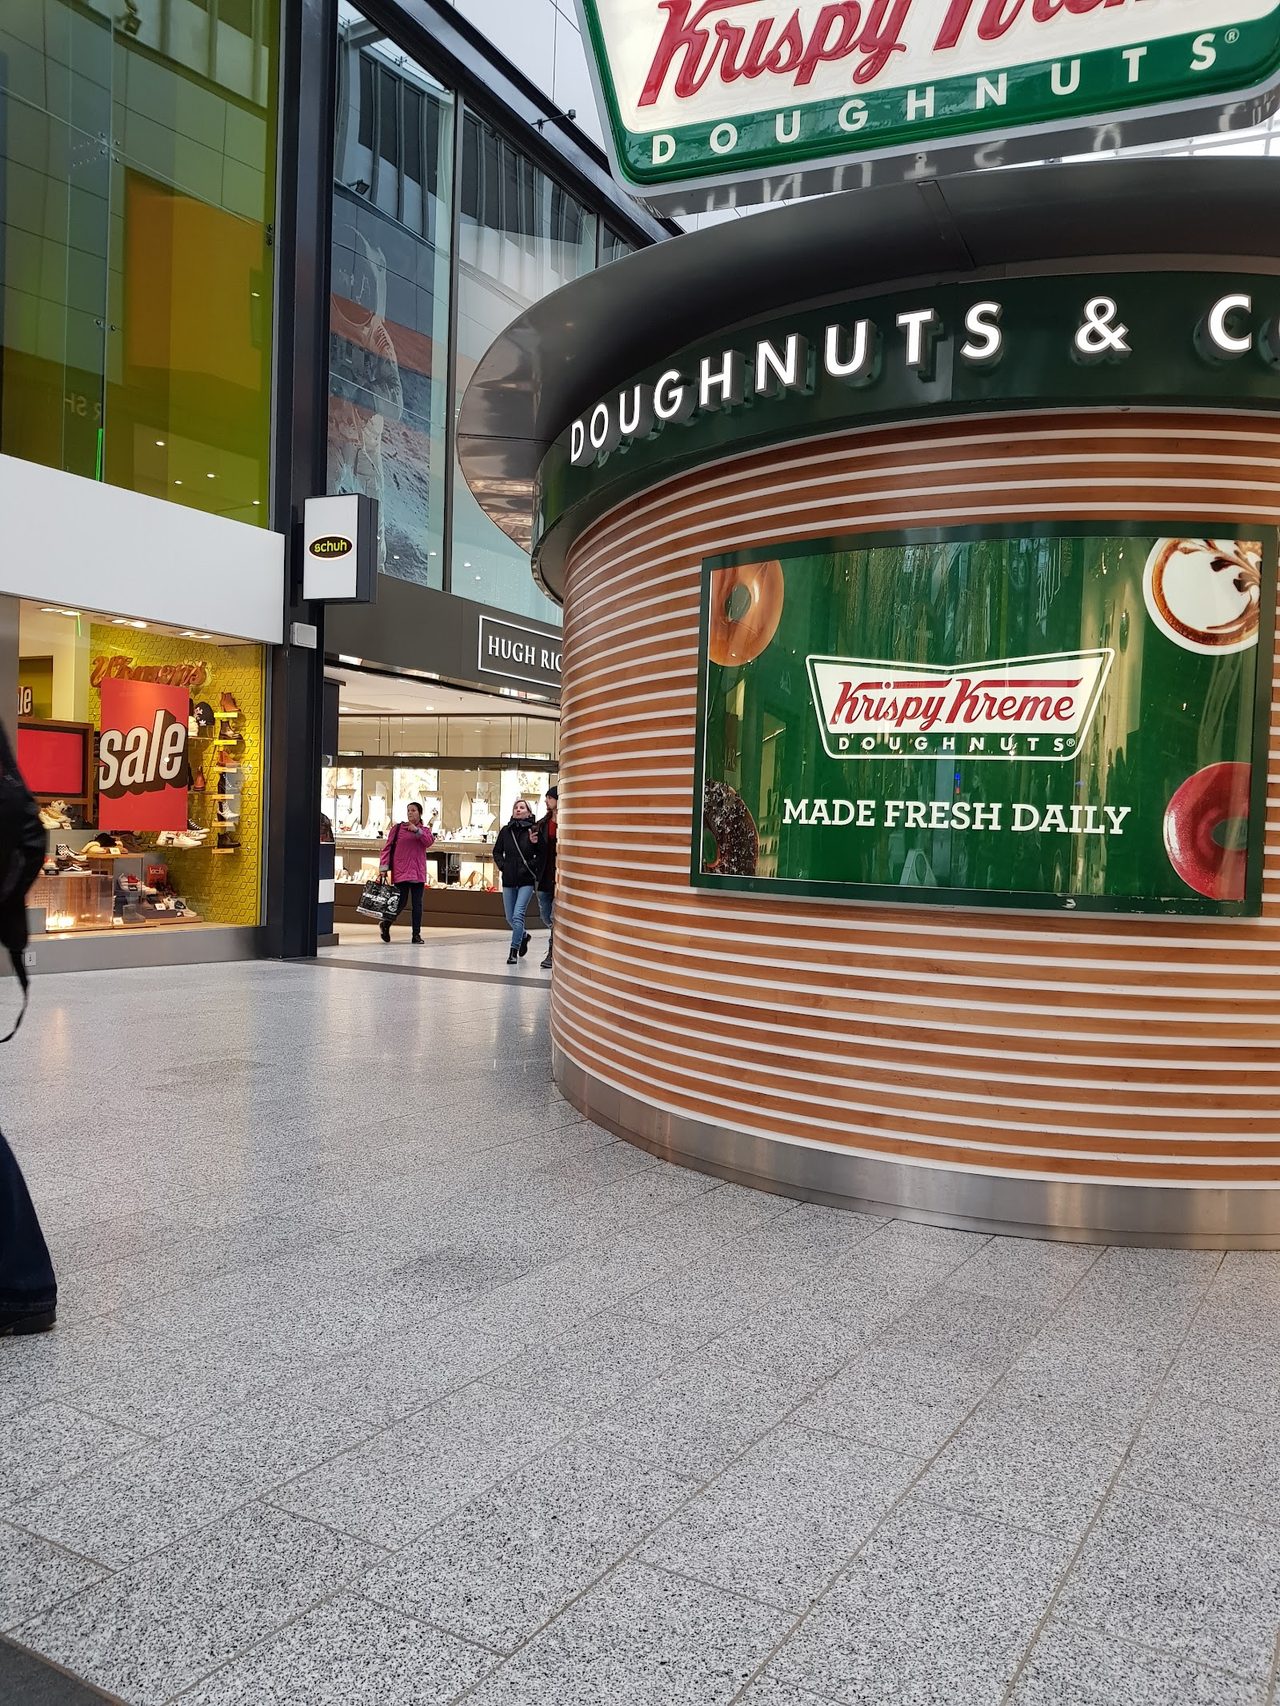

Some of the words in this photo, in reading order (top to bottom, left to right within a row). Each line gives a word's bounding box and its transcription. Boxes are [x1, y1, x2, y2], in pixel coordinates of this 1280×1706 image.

[570, 300, 1002, 466] DOUGHNUTS
[1074, 296, 1133, 354] &
[314, 540, 348, 553] schuh
[488, 635, 536, 666] HUGH
[829, 678, 952, 731] Krispy
[945, 677, 1084, 724] Kreme
[99, 709, 188, 792] sale
[782, 798, 876, 827] MADE
[884, 800, 1002, 831] FRESH
[1011, 803, 1132, 836] DAILY
